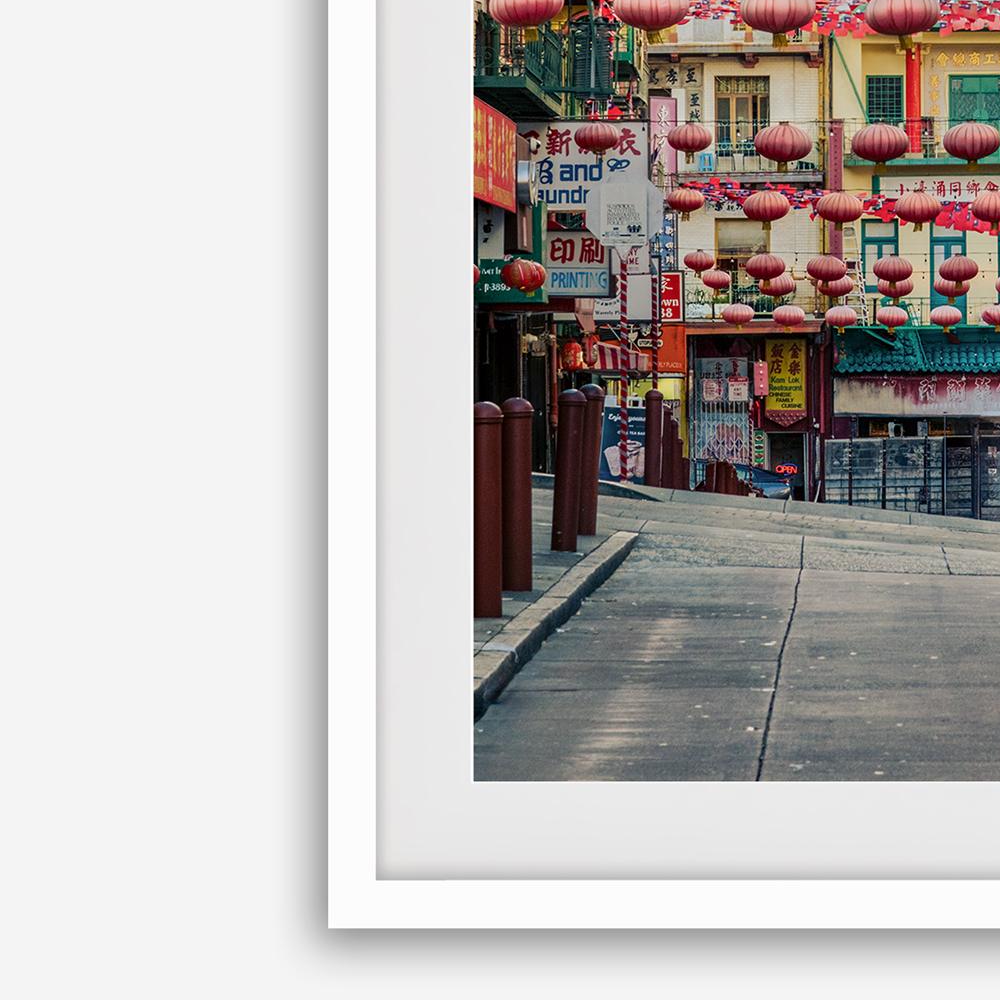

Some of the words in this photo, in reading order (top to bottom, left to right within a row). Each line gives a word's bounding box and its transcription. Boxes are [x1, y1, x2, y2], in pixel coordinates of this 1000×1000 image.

[560, 160, 603, 181] and
[538, 187, 590, 203] aundr
[550, 236, 604, 265] 印刷
[775, 465, 797, 474] OPEN
